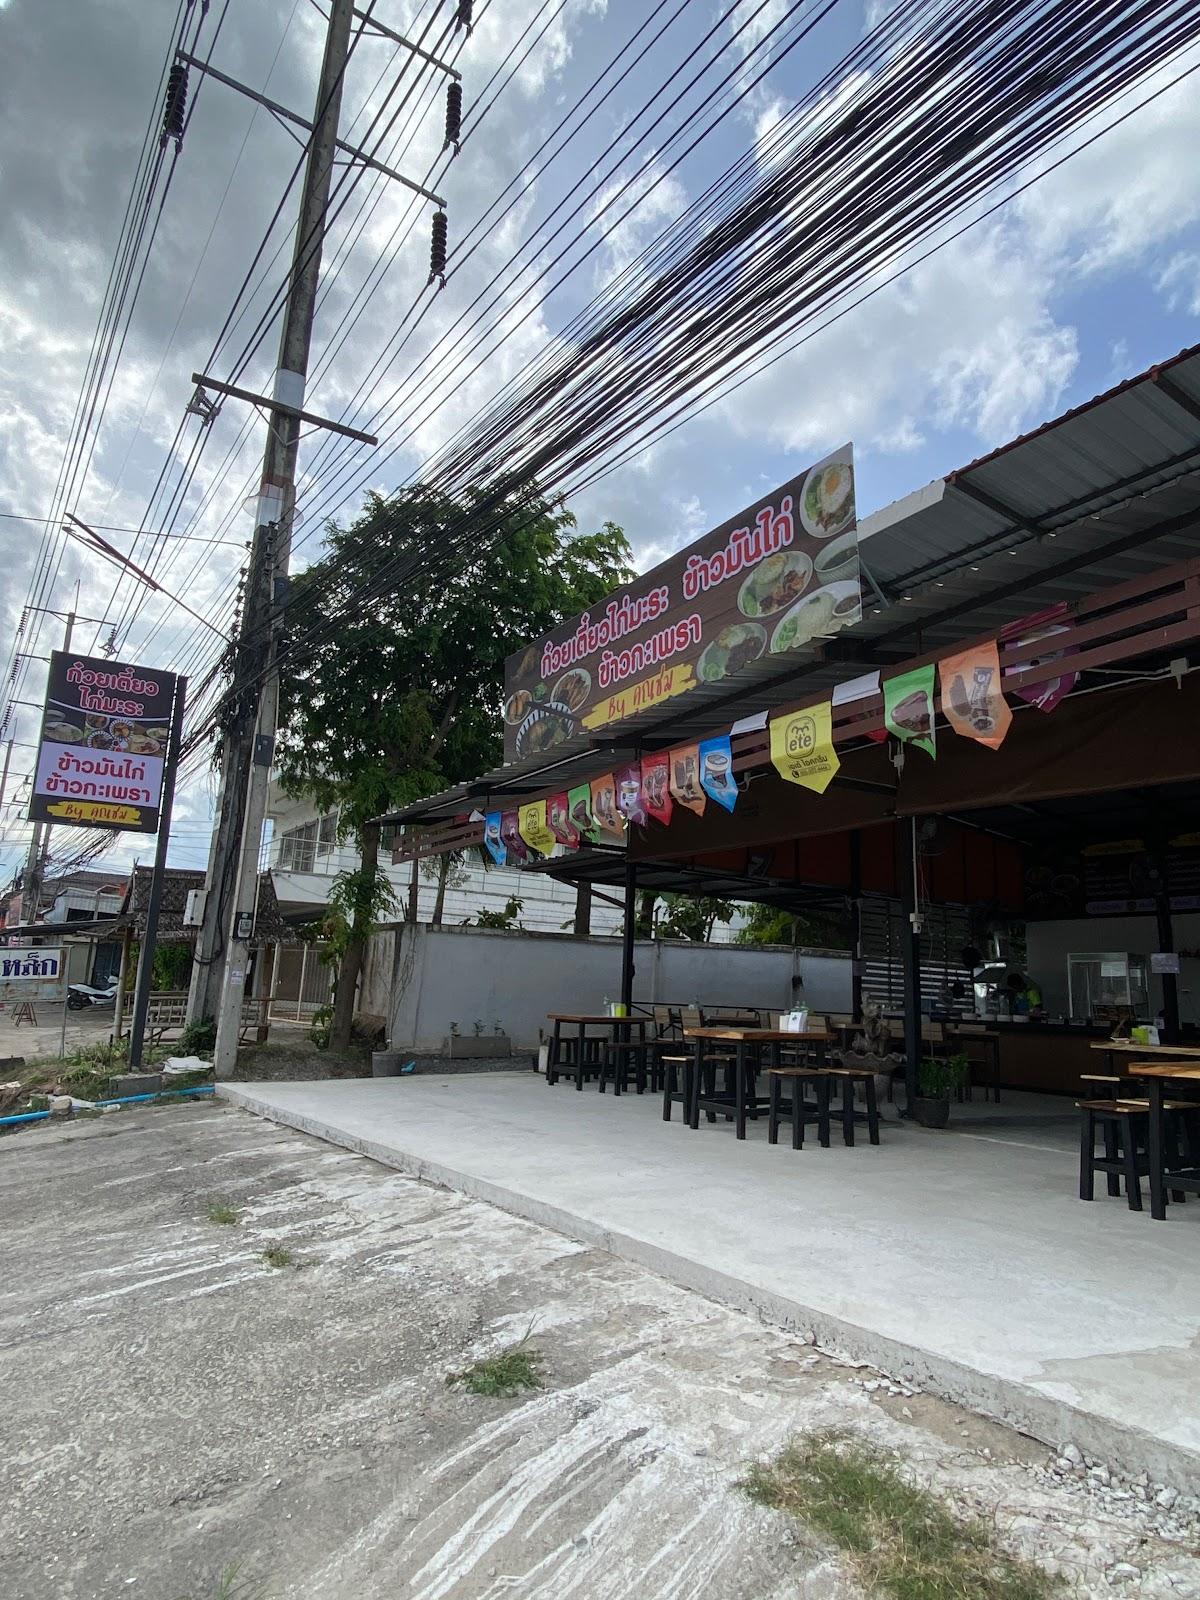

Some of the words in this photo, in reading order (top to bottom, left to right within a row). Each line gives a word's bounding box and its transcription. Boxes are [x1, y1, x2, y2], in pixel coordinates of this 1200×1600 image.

[681, 493, 796, 599] ข้าวมันไก่
[597, 611, 704, 689] ข้าวกะเพรา
[66, 661, 160, 697] ก๋วยเตี๋ยว
[78, 685, 145, 717] ไก่มะระ
[607, 697, 626, 720] By
[789, 734, 812, 753] ete
[58, 751, 146, 781] ข้าวมันไก่
[45, 772, 151, 803] ข้าวกะเพรา
[64, 804, 83, 822] By
[0, 951, 58, 977] หล็ก
